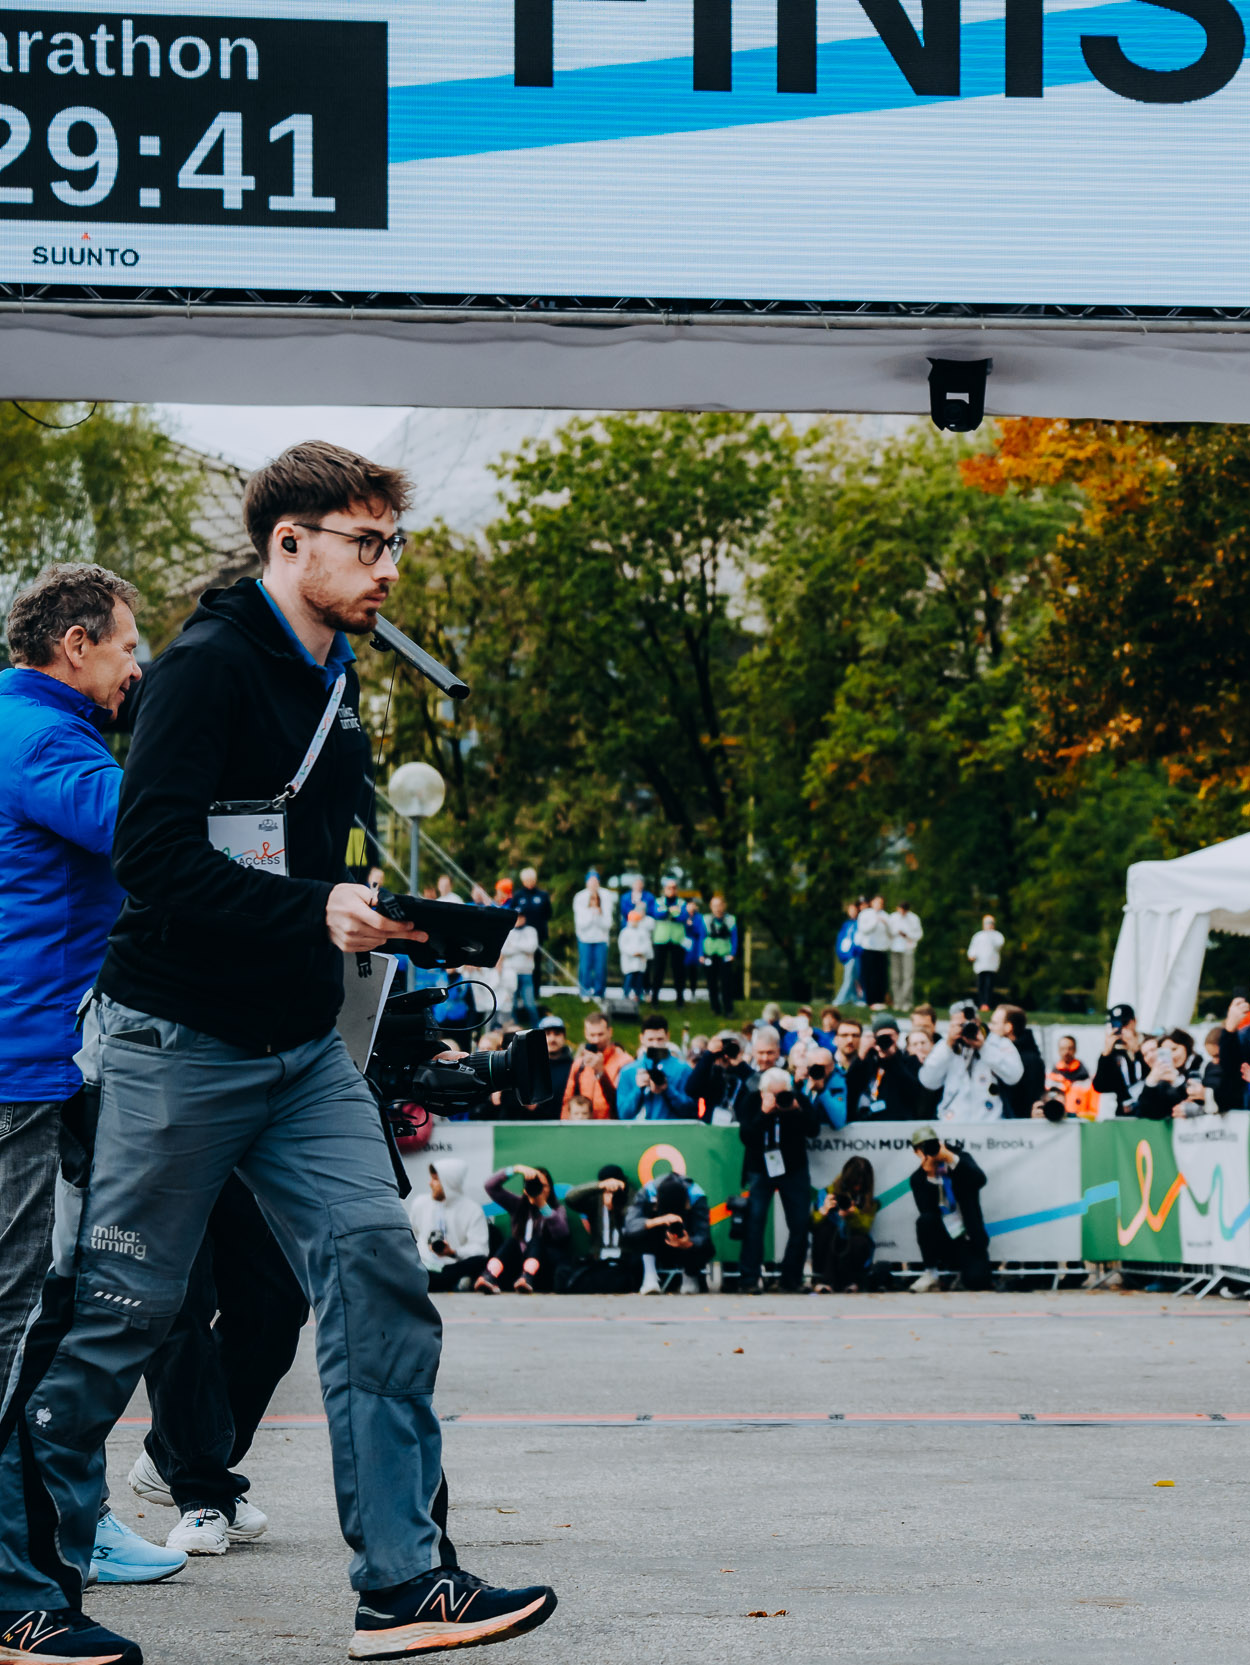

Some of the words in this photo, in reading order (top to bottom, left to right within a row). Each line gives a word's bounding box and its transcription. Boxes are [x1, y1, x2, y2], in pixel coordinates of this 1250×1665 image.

[0, 19, 260, 81] rathon
[31, 245, 140, 268] SUUNTO
[239, 856, 281, 866] ACCESS
[986, 1137, 1034, 1151] Brooks
[92, 1224, 140, 1243] mika:
[90, 1236, 147, 1260] timing
